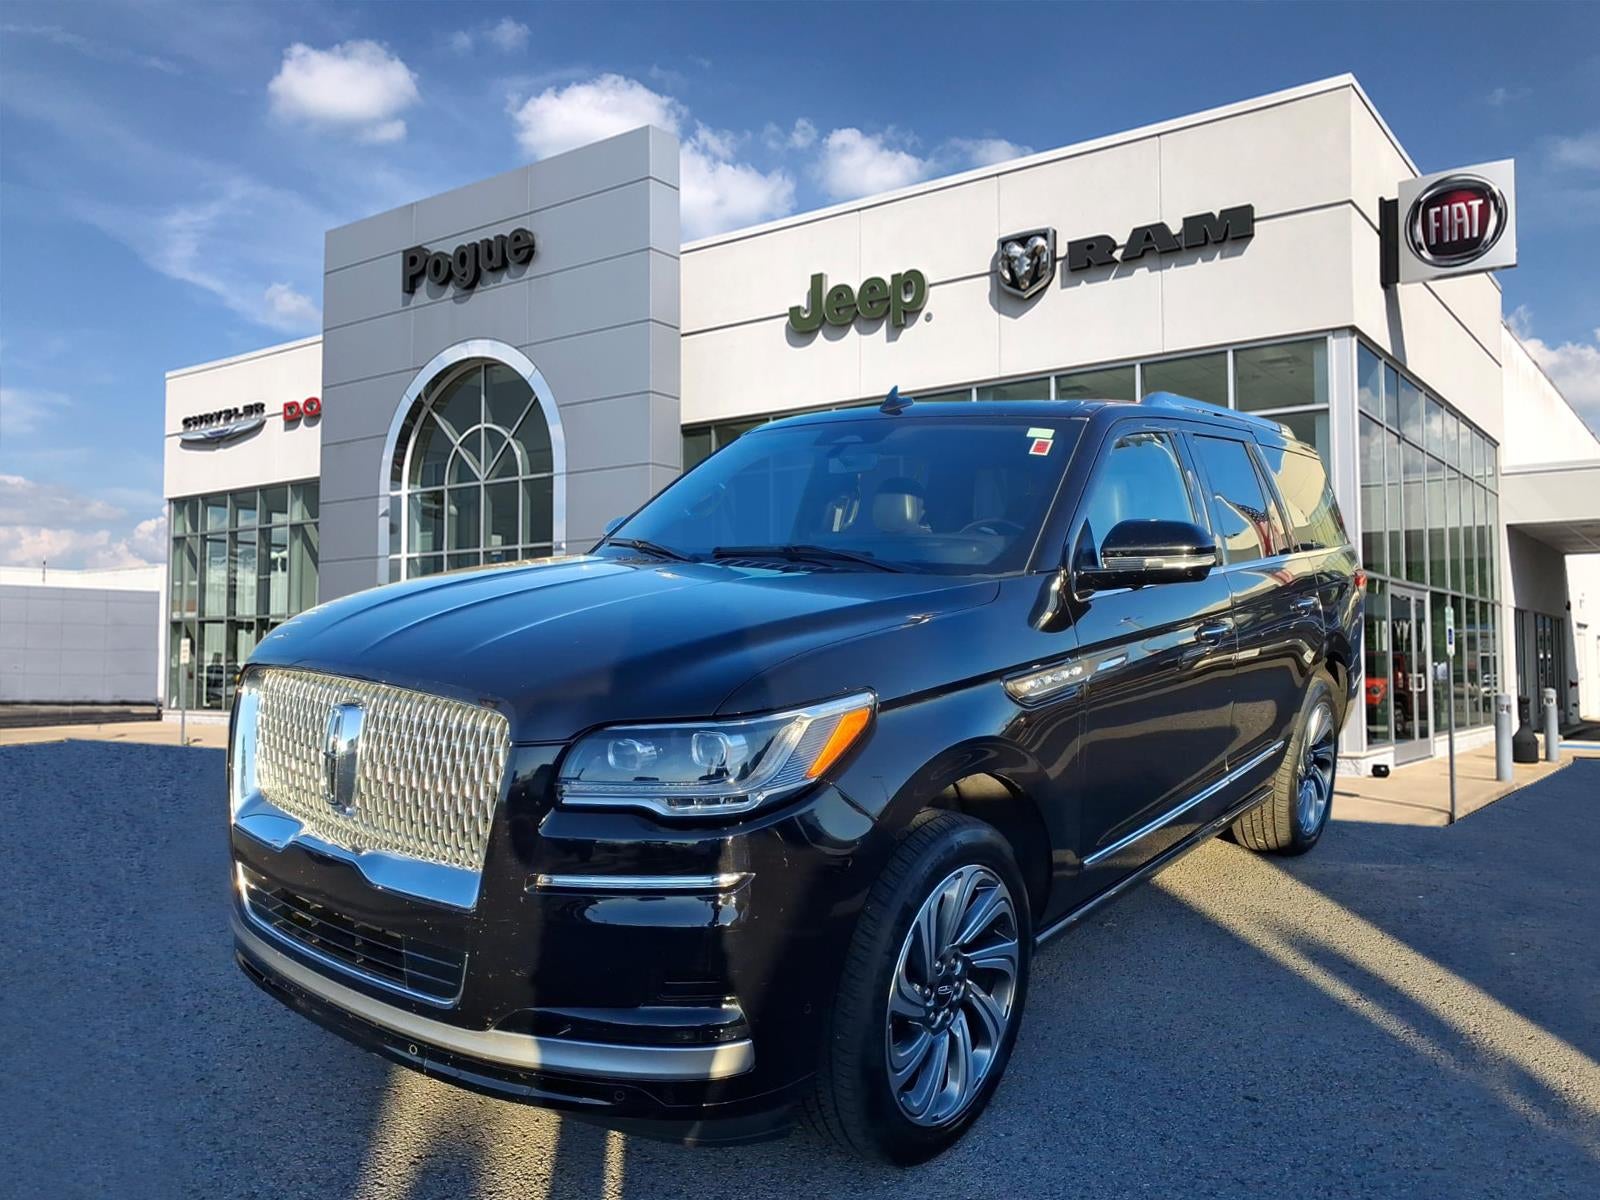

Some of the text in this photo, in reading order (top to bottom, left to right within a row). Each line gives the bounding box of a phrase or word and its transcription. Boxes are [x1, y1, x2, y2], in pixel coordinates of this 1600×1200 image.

[1067, 203, 1254, 271] RAM
[1428, 199, 1484, 246] FIAT
[402, 227, 535, 294] Pogue
[788, 268, 929, 333] Jeep
[182, 402, 266, 429] CHRYSLER
